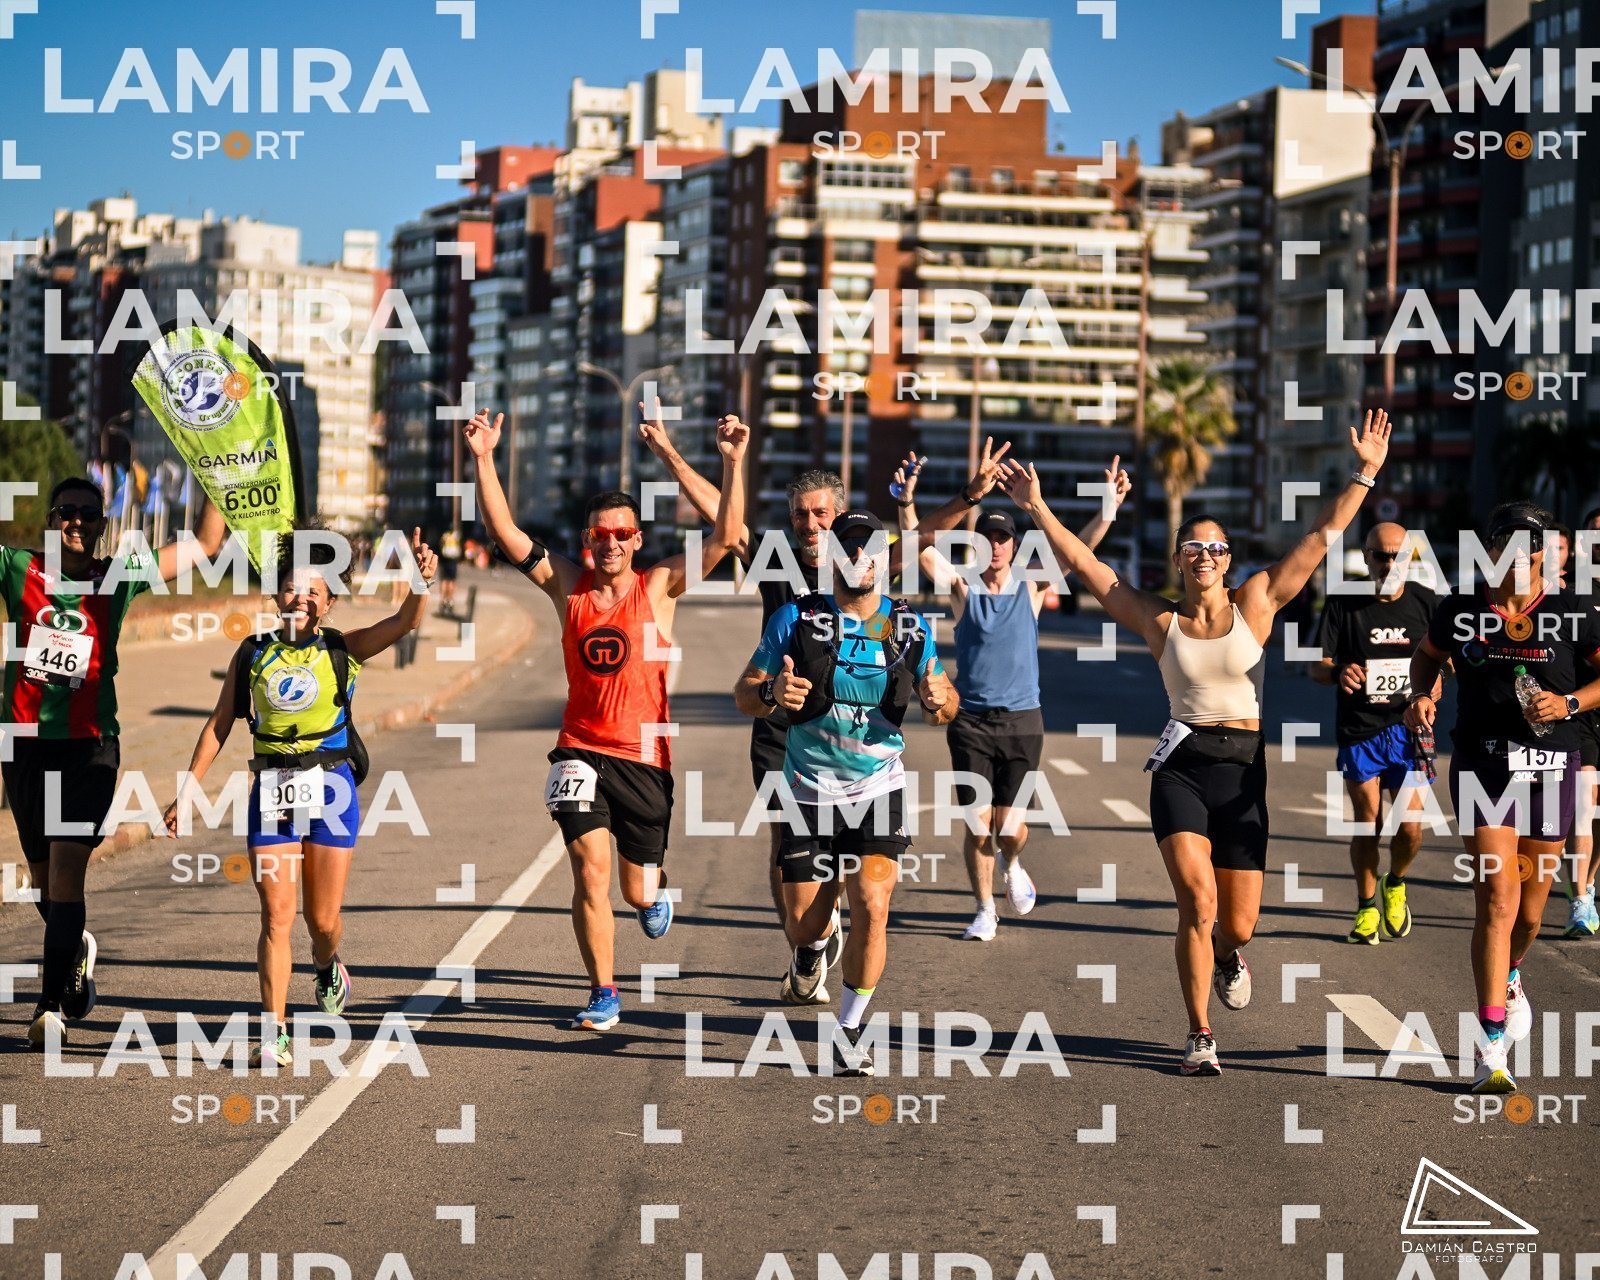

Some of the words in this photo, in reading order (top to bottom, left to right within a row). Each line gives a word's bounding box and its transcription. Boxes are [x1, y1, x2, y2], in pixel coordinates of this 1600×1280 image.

[198, 448, 278, 468] GARMIN
[224, 482, 246, 490] RITMO
[239, 507, 281, 519] KILOMETRO
[1369, 627, 1407, 645] 30K
[38, 647, 79, 673] 446
[1375, 675, 1408, 691] 287
[1153, 736, 1170, 757] 2
[1521, 746, 1557, 766] 157
[270, 783, 312, 806] 908
[548, 778, 585, 800] 247
